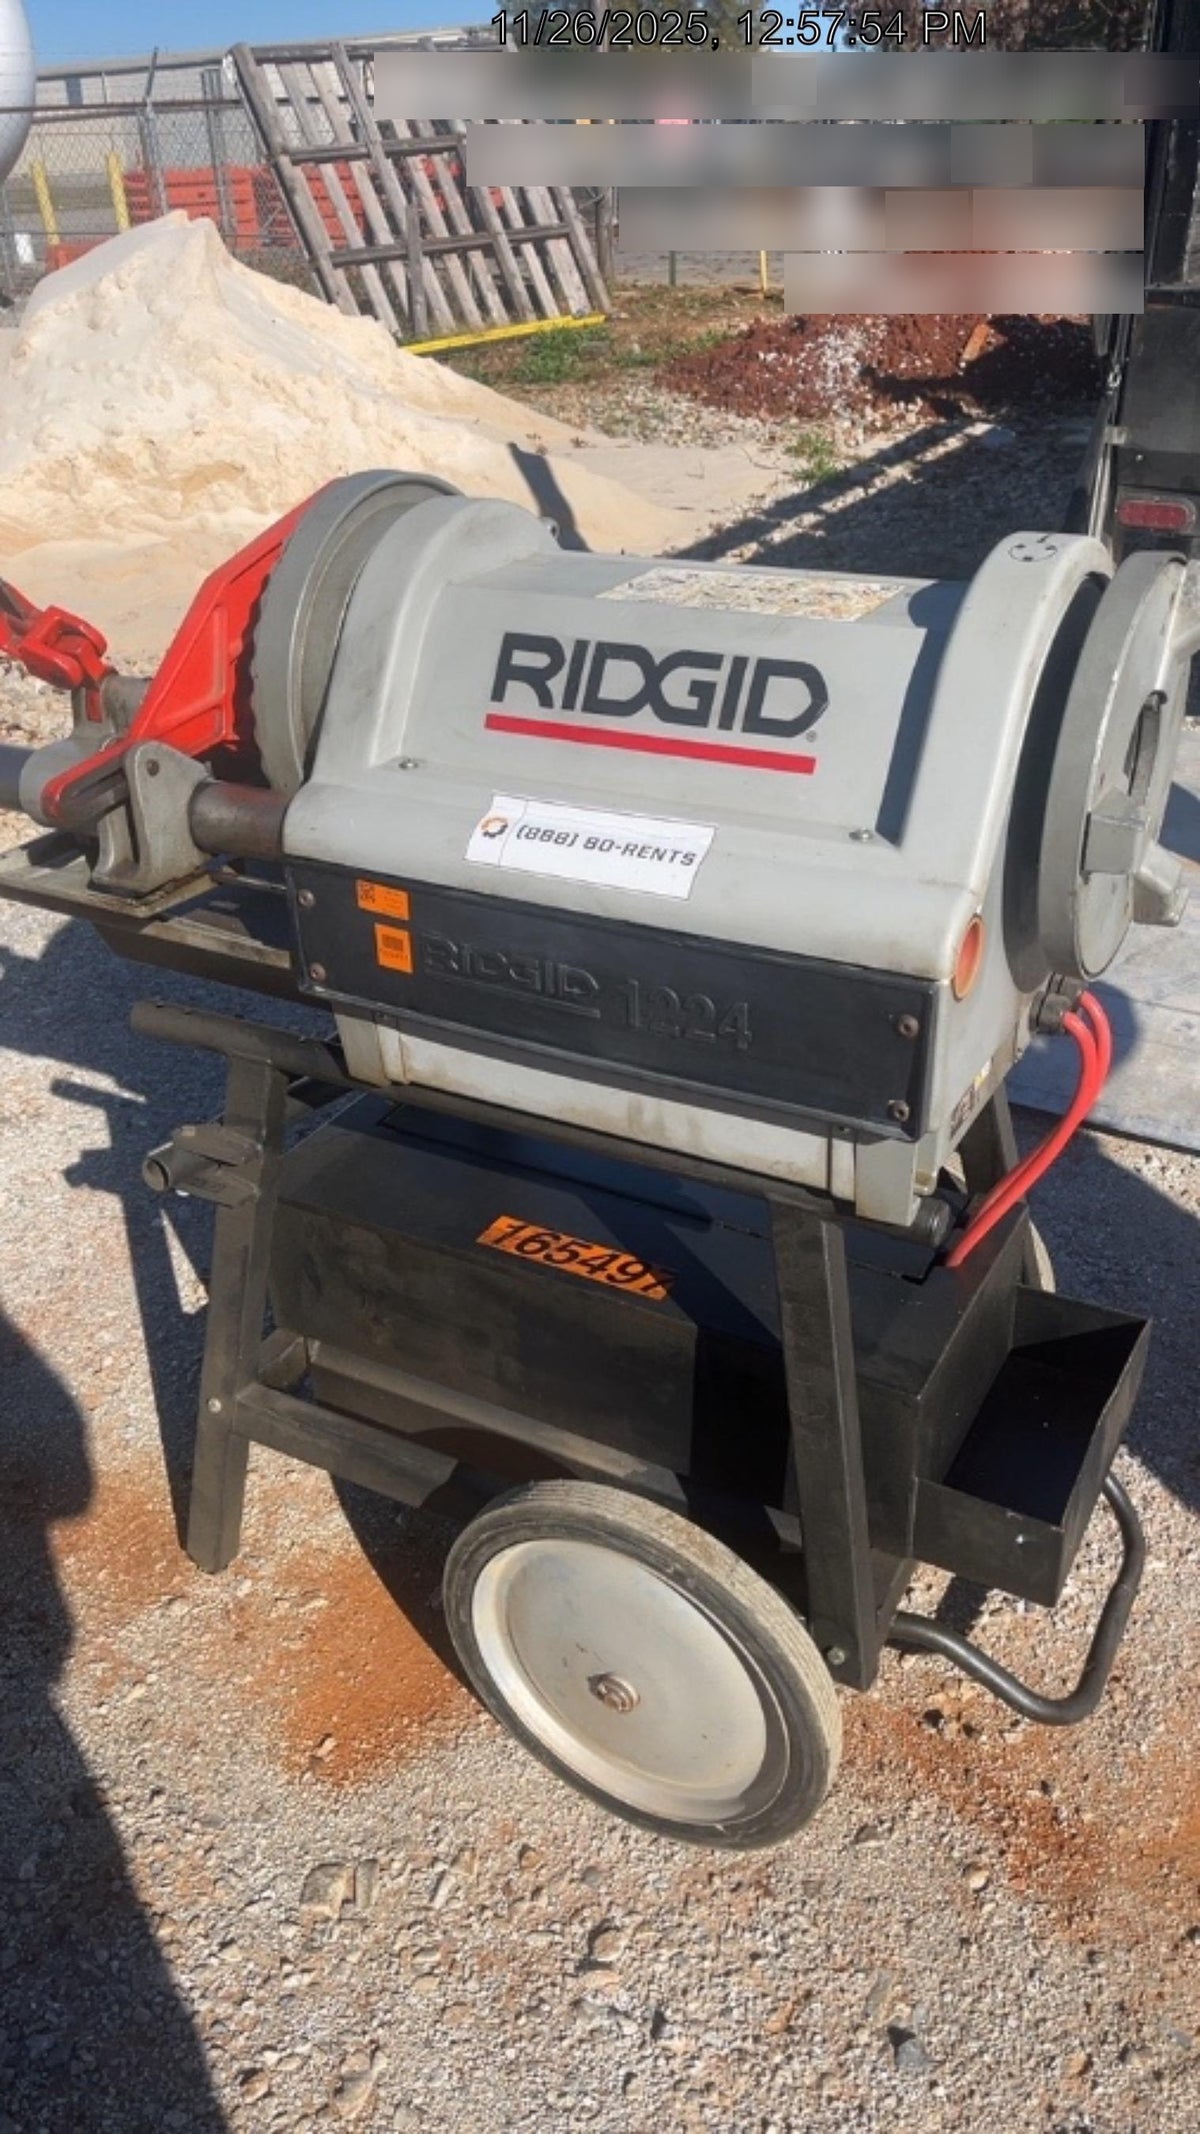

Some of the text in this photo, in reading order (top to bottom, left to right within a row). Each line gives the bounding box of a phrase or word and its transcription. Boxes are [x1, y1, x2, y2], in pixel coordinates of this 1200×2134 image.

[491, 632, 829, 738] RIDGID
[516, 823, 578, 848] (888)
[423, 931, 753, 1051] RIDGID 1224
